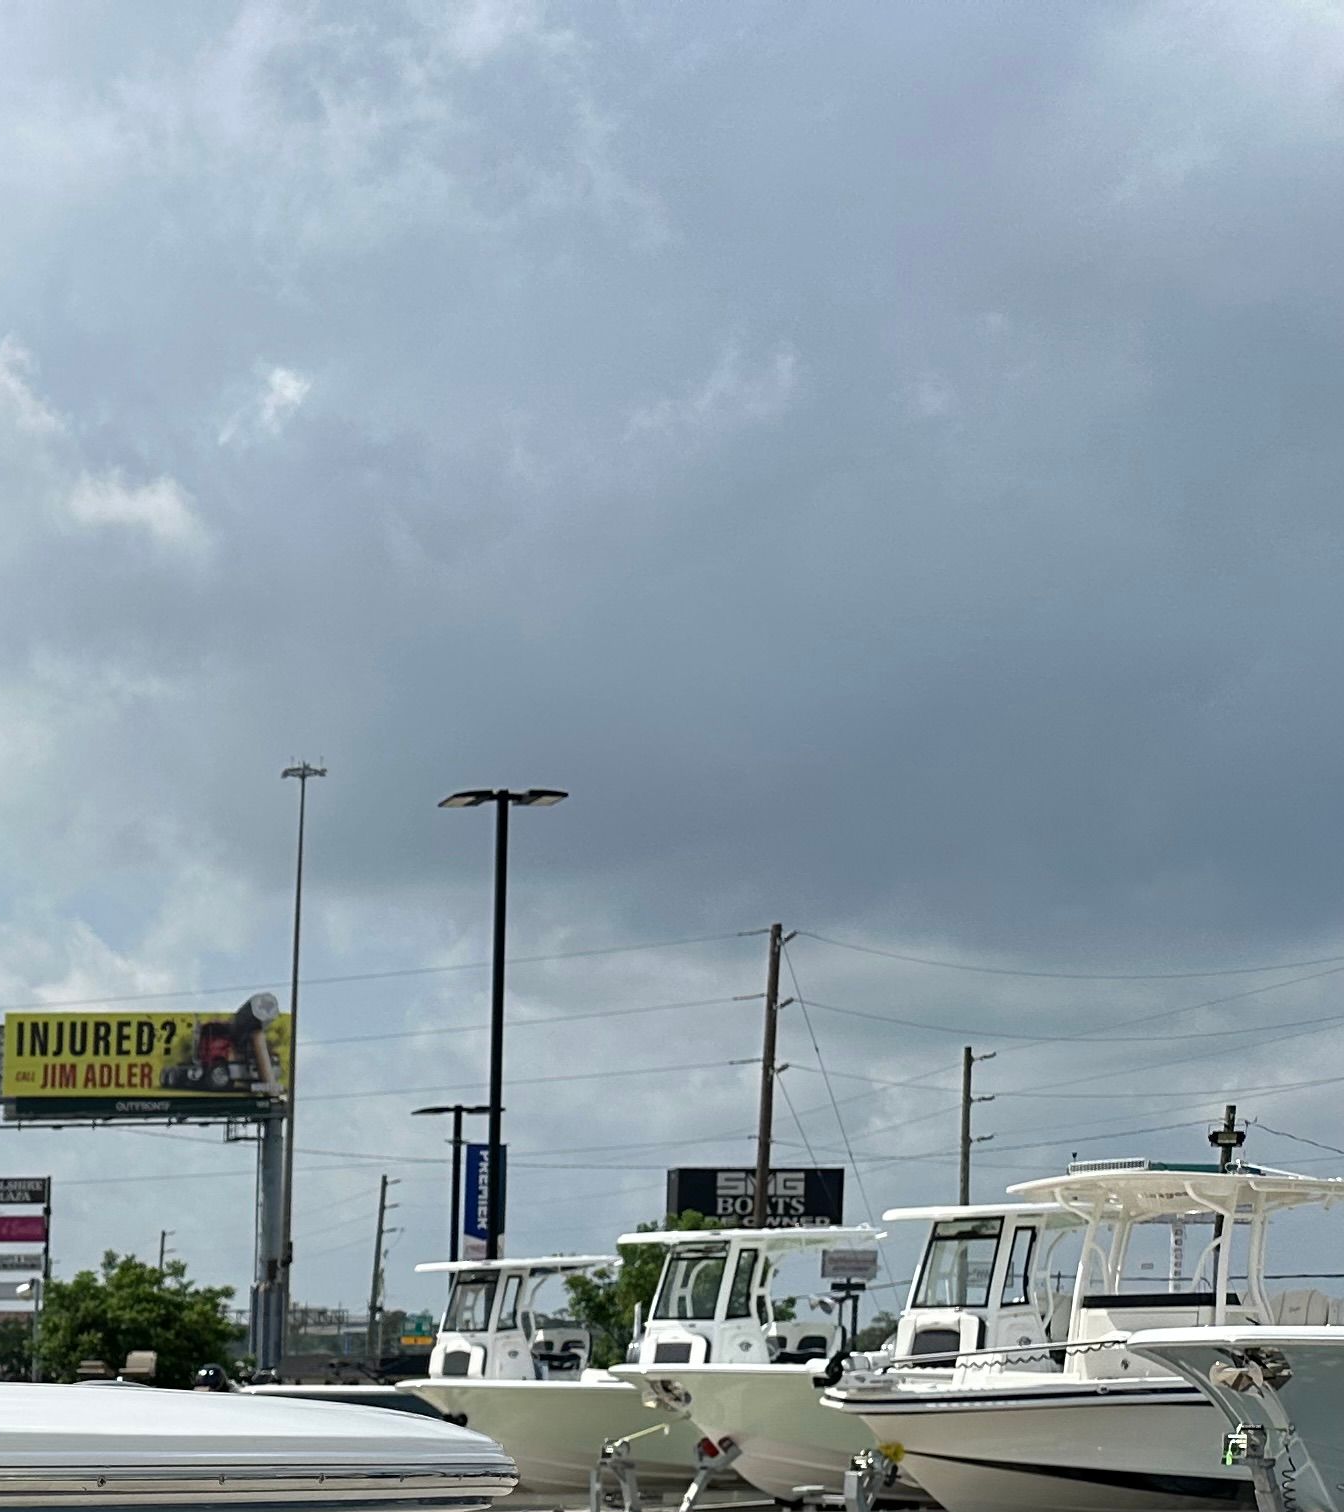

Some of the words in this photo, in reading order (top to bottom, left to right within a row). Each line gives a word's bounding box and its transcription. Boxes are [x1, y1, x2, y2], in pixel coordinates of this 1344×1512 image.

[16, 1020, 177, 1057] INJURED?
[40, 1063, 77, 1089] JIM
[83, 1062, 153, 1089] ADLER
[717, 1196, 805, 1215] BOTS
